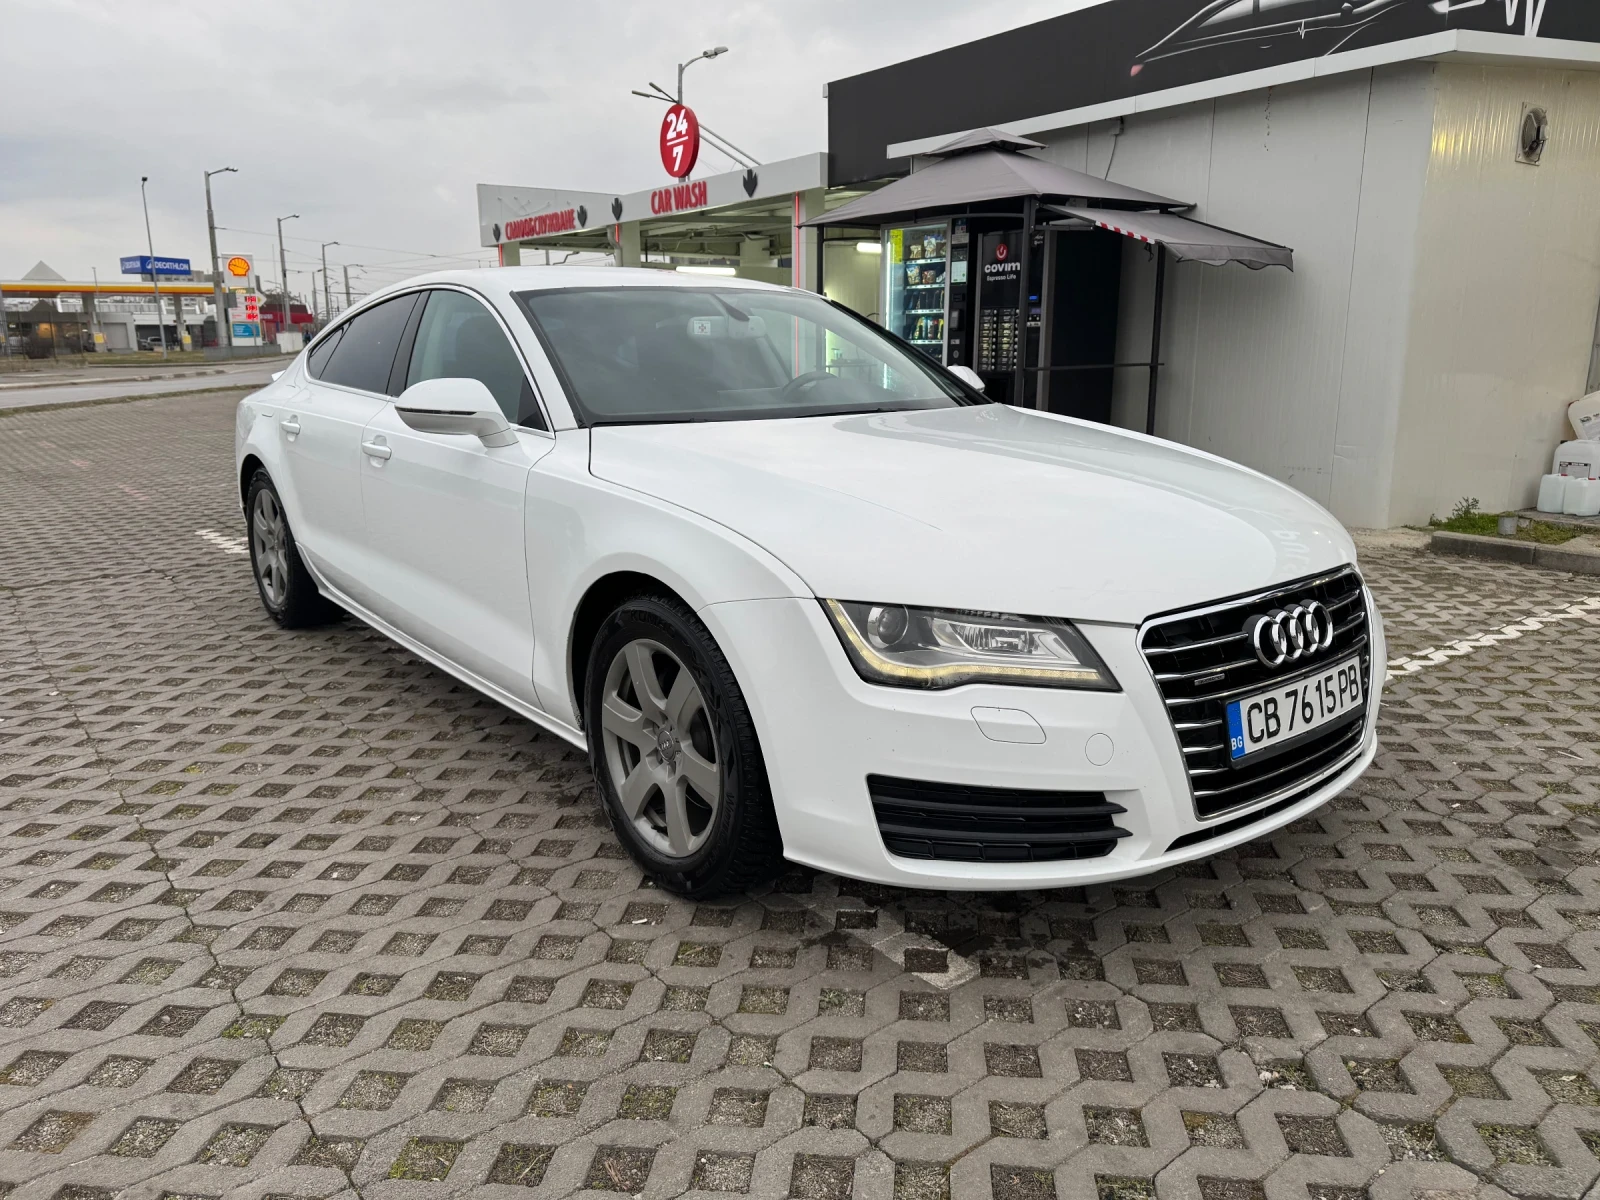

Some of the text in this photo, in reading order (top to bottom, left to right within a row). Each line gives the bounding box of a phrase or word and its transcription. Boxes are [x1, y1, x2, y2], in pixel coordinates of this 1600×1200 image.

[666, 108, 688, 140] 24
[672, 144, 684, 172] 7
[650, 180, 707, 215] CAR WASH
[154, 261, 189, 271] DECATHLON
[984, 261, 1021, 273] covim
[986, 274, 1006, 282] Espresso
[1246, 663, 1359, 744] CB 7615 PB
[1230, 735, 1243, 751] BG
